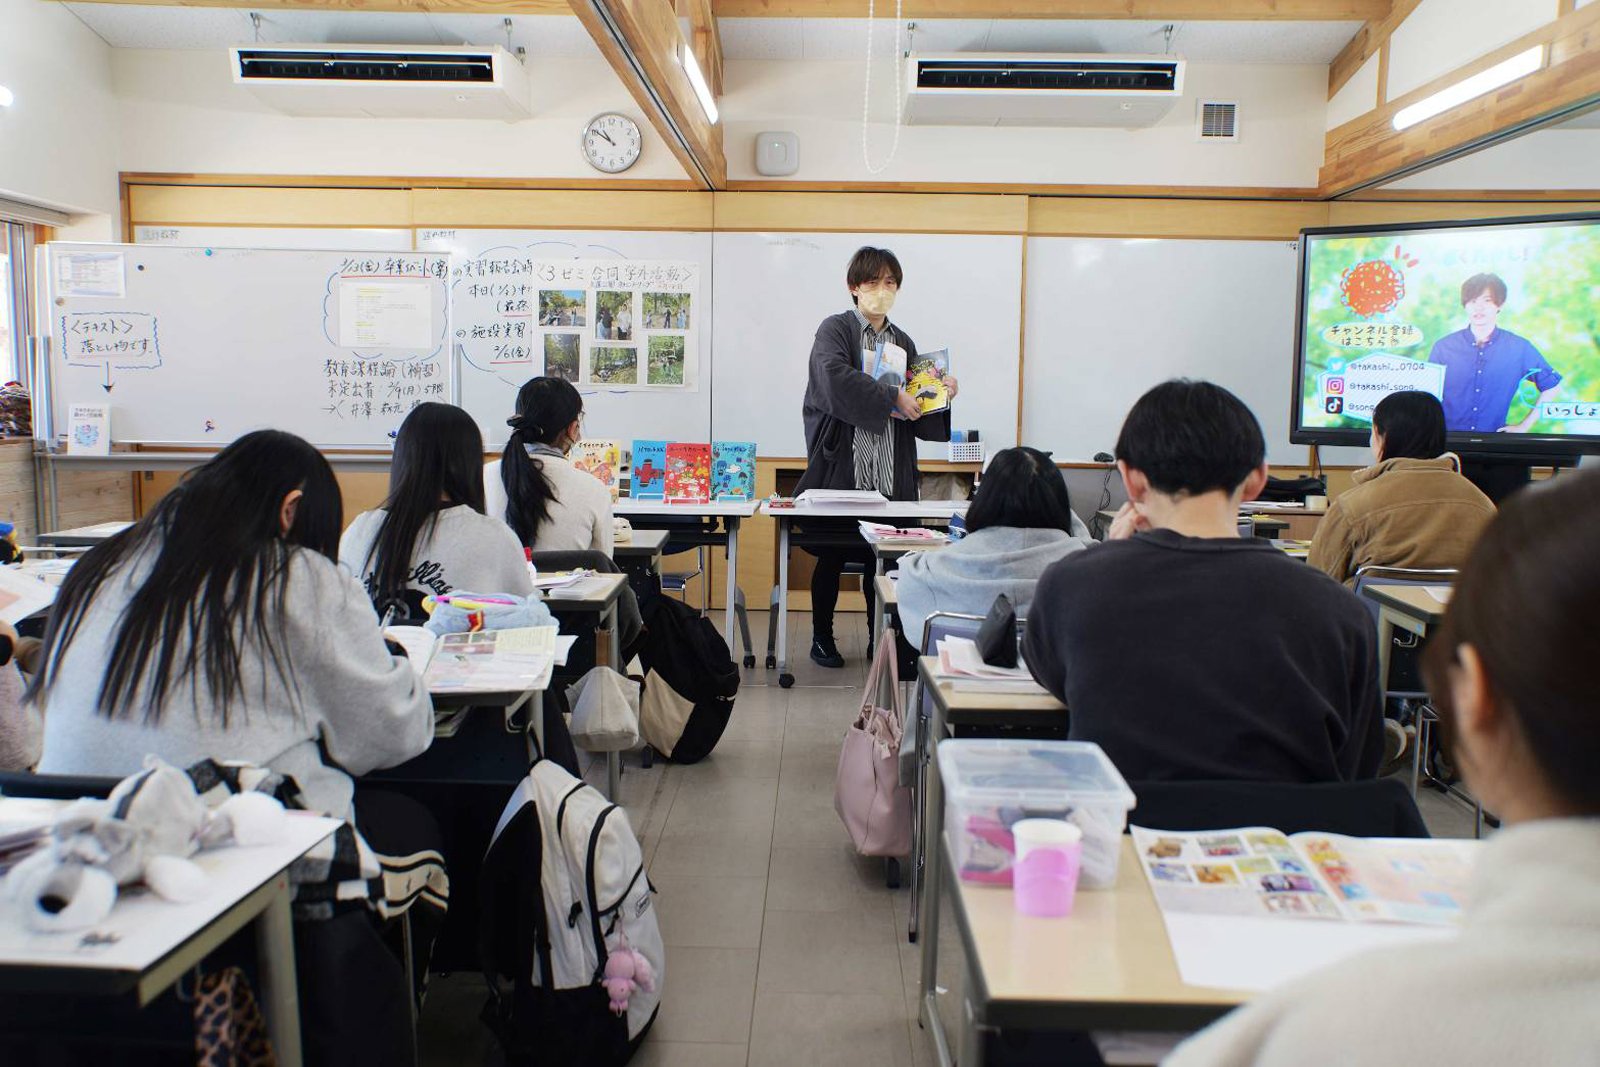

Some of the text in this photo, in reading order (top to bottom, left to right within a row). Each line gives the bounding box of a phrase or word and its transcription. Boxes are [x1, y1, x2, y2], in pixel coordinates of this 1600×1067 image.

[627, 128, 632, 136] 2
[631, 138, 635, 146] 3
[592, 149, 597, 157] 8
[610, 159, 615, 167] 6
[620, 156, 625, 164] 5
[1341, 336, 1386, 347] はこちら
[1546, 404, 1600, 418] いっしょ
